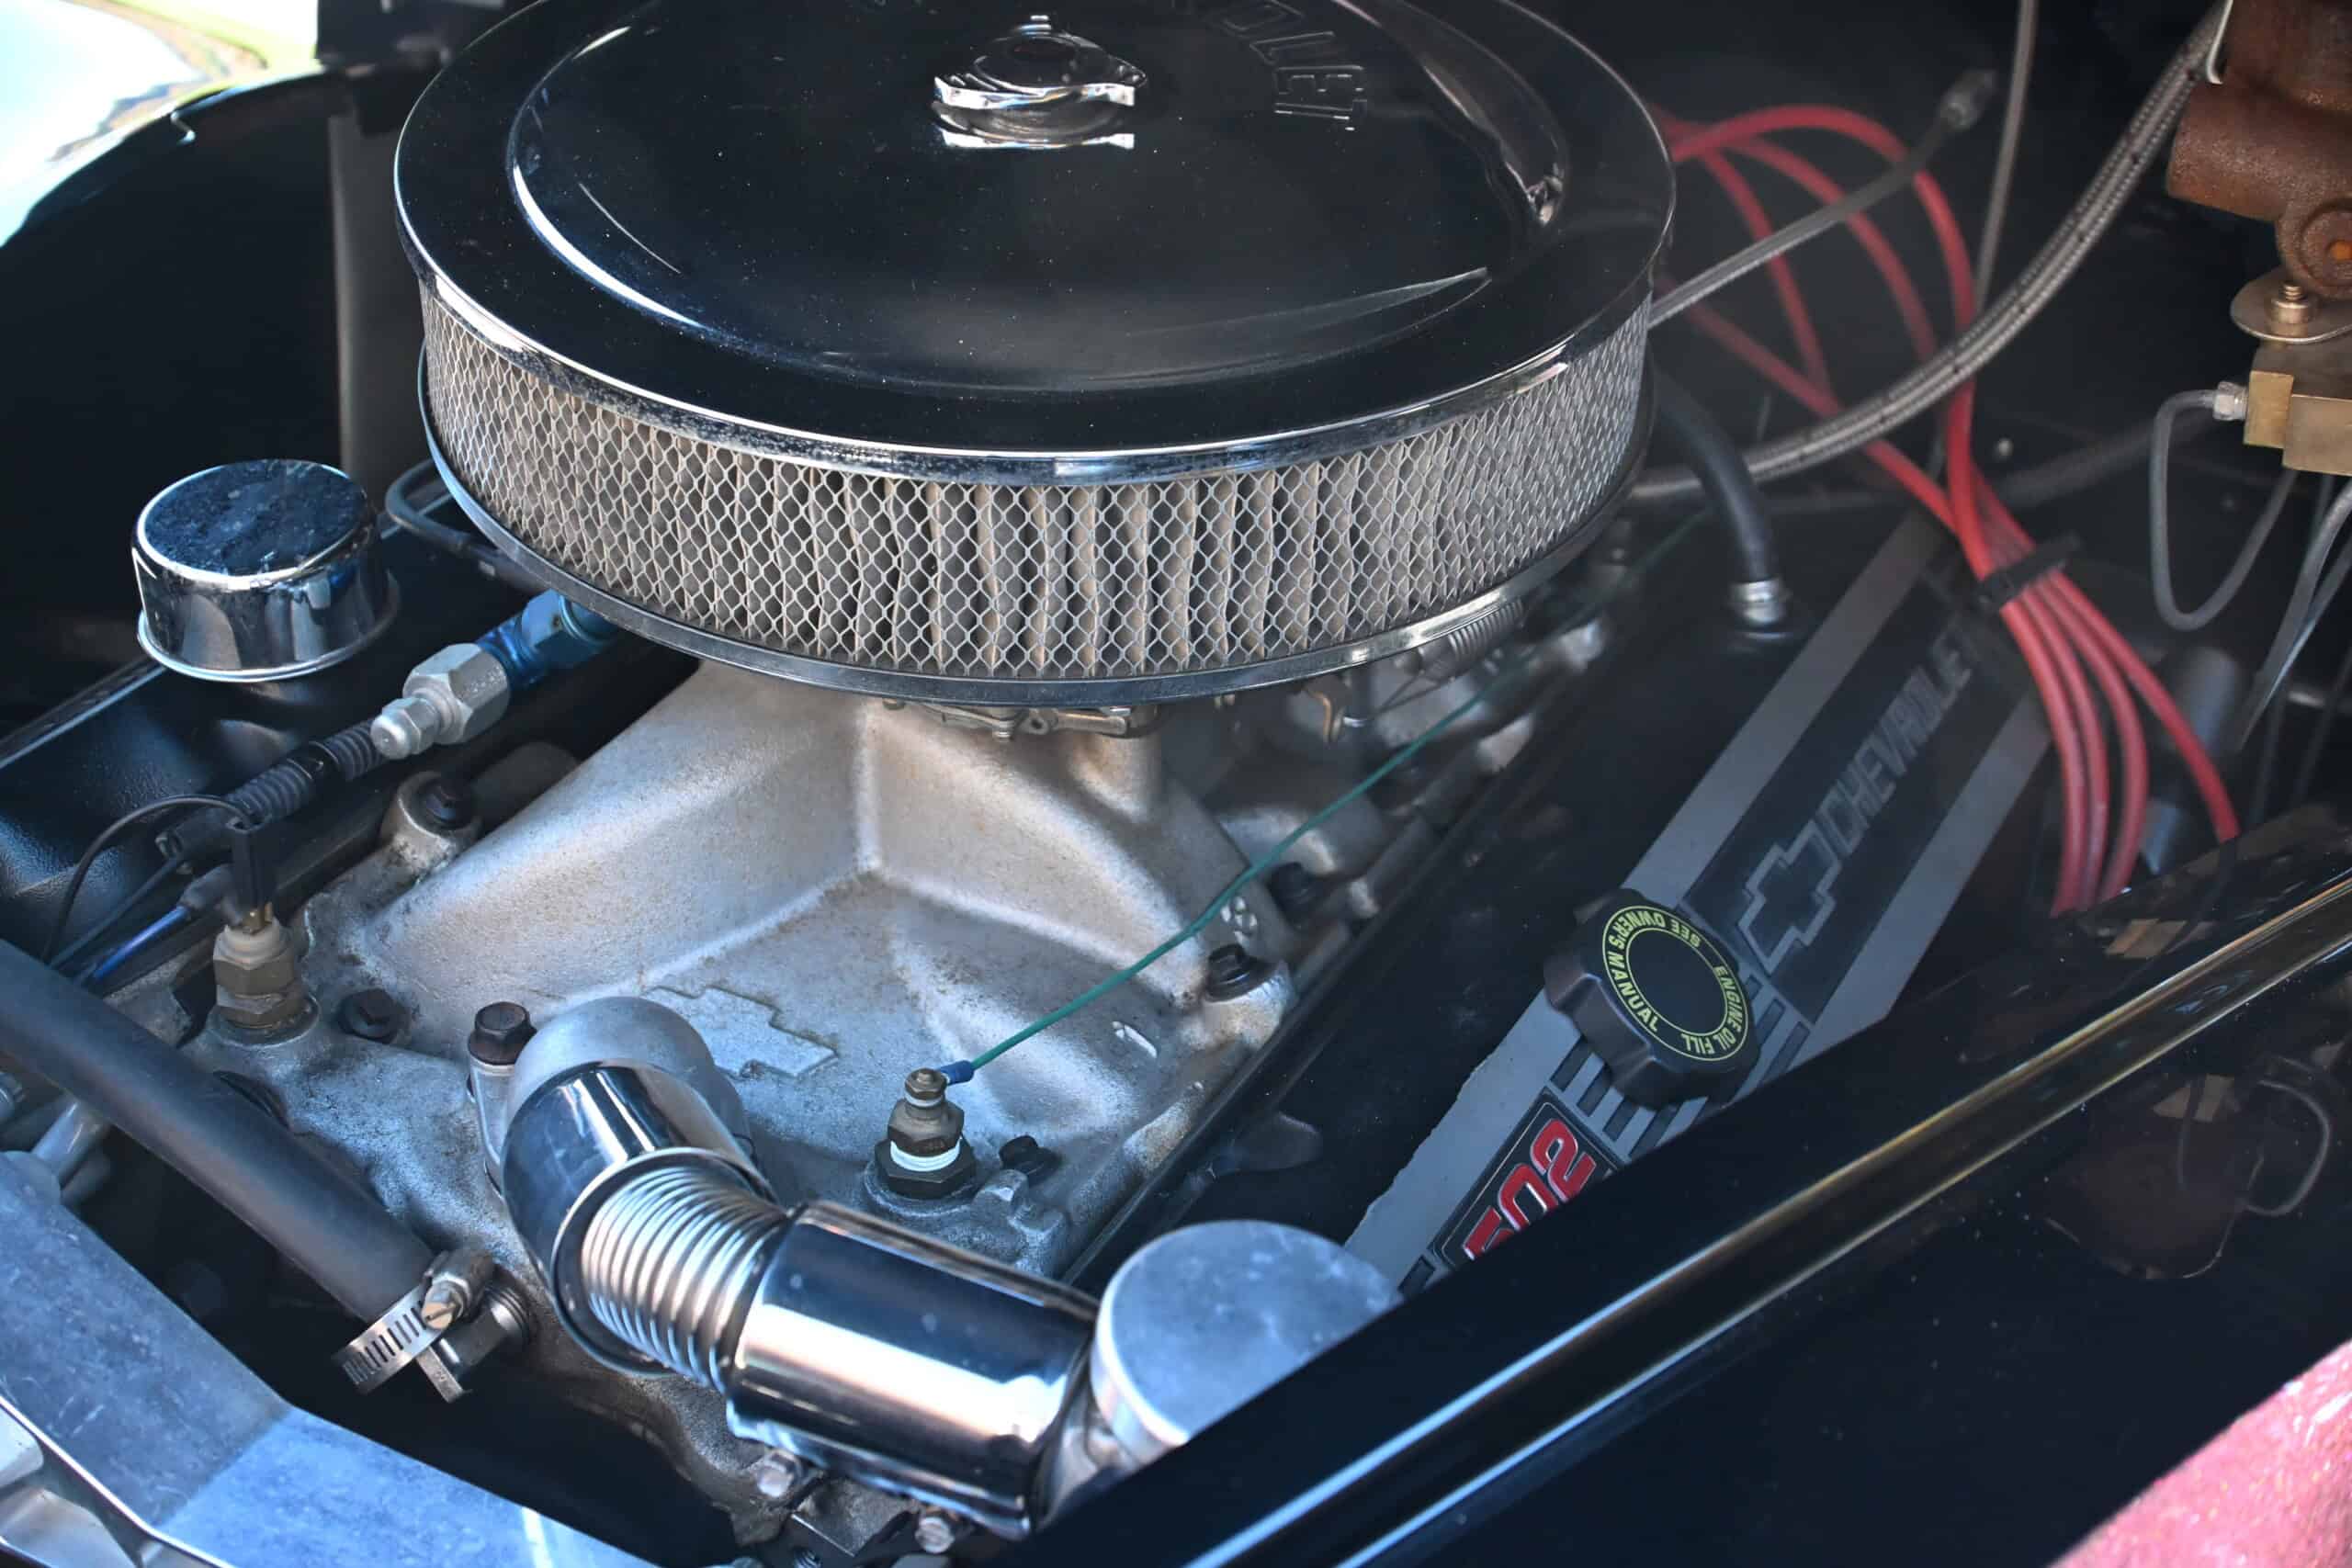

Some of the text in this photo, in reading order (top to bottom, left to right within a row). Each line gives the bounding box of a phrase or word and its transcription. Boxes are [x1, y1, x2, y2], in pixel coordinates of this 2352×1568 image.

[1607, 911, 1701, 1032] SEE OWNER'S MANUAL
[1681, 966, 1742, 1055] ENGINE OIL FILL
